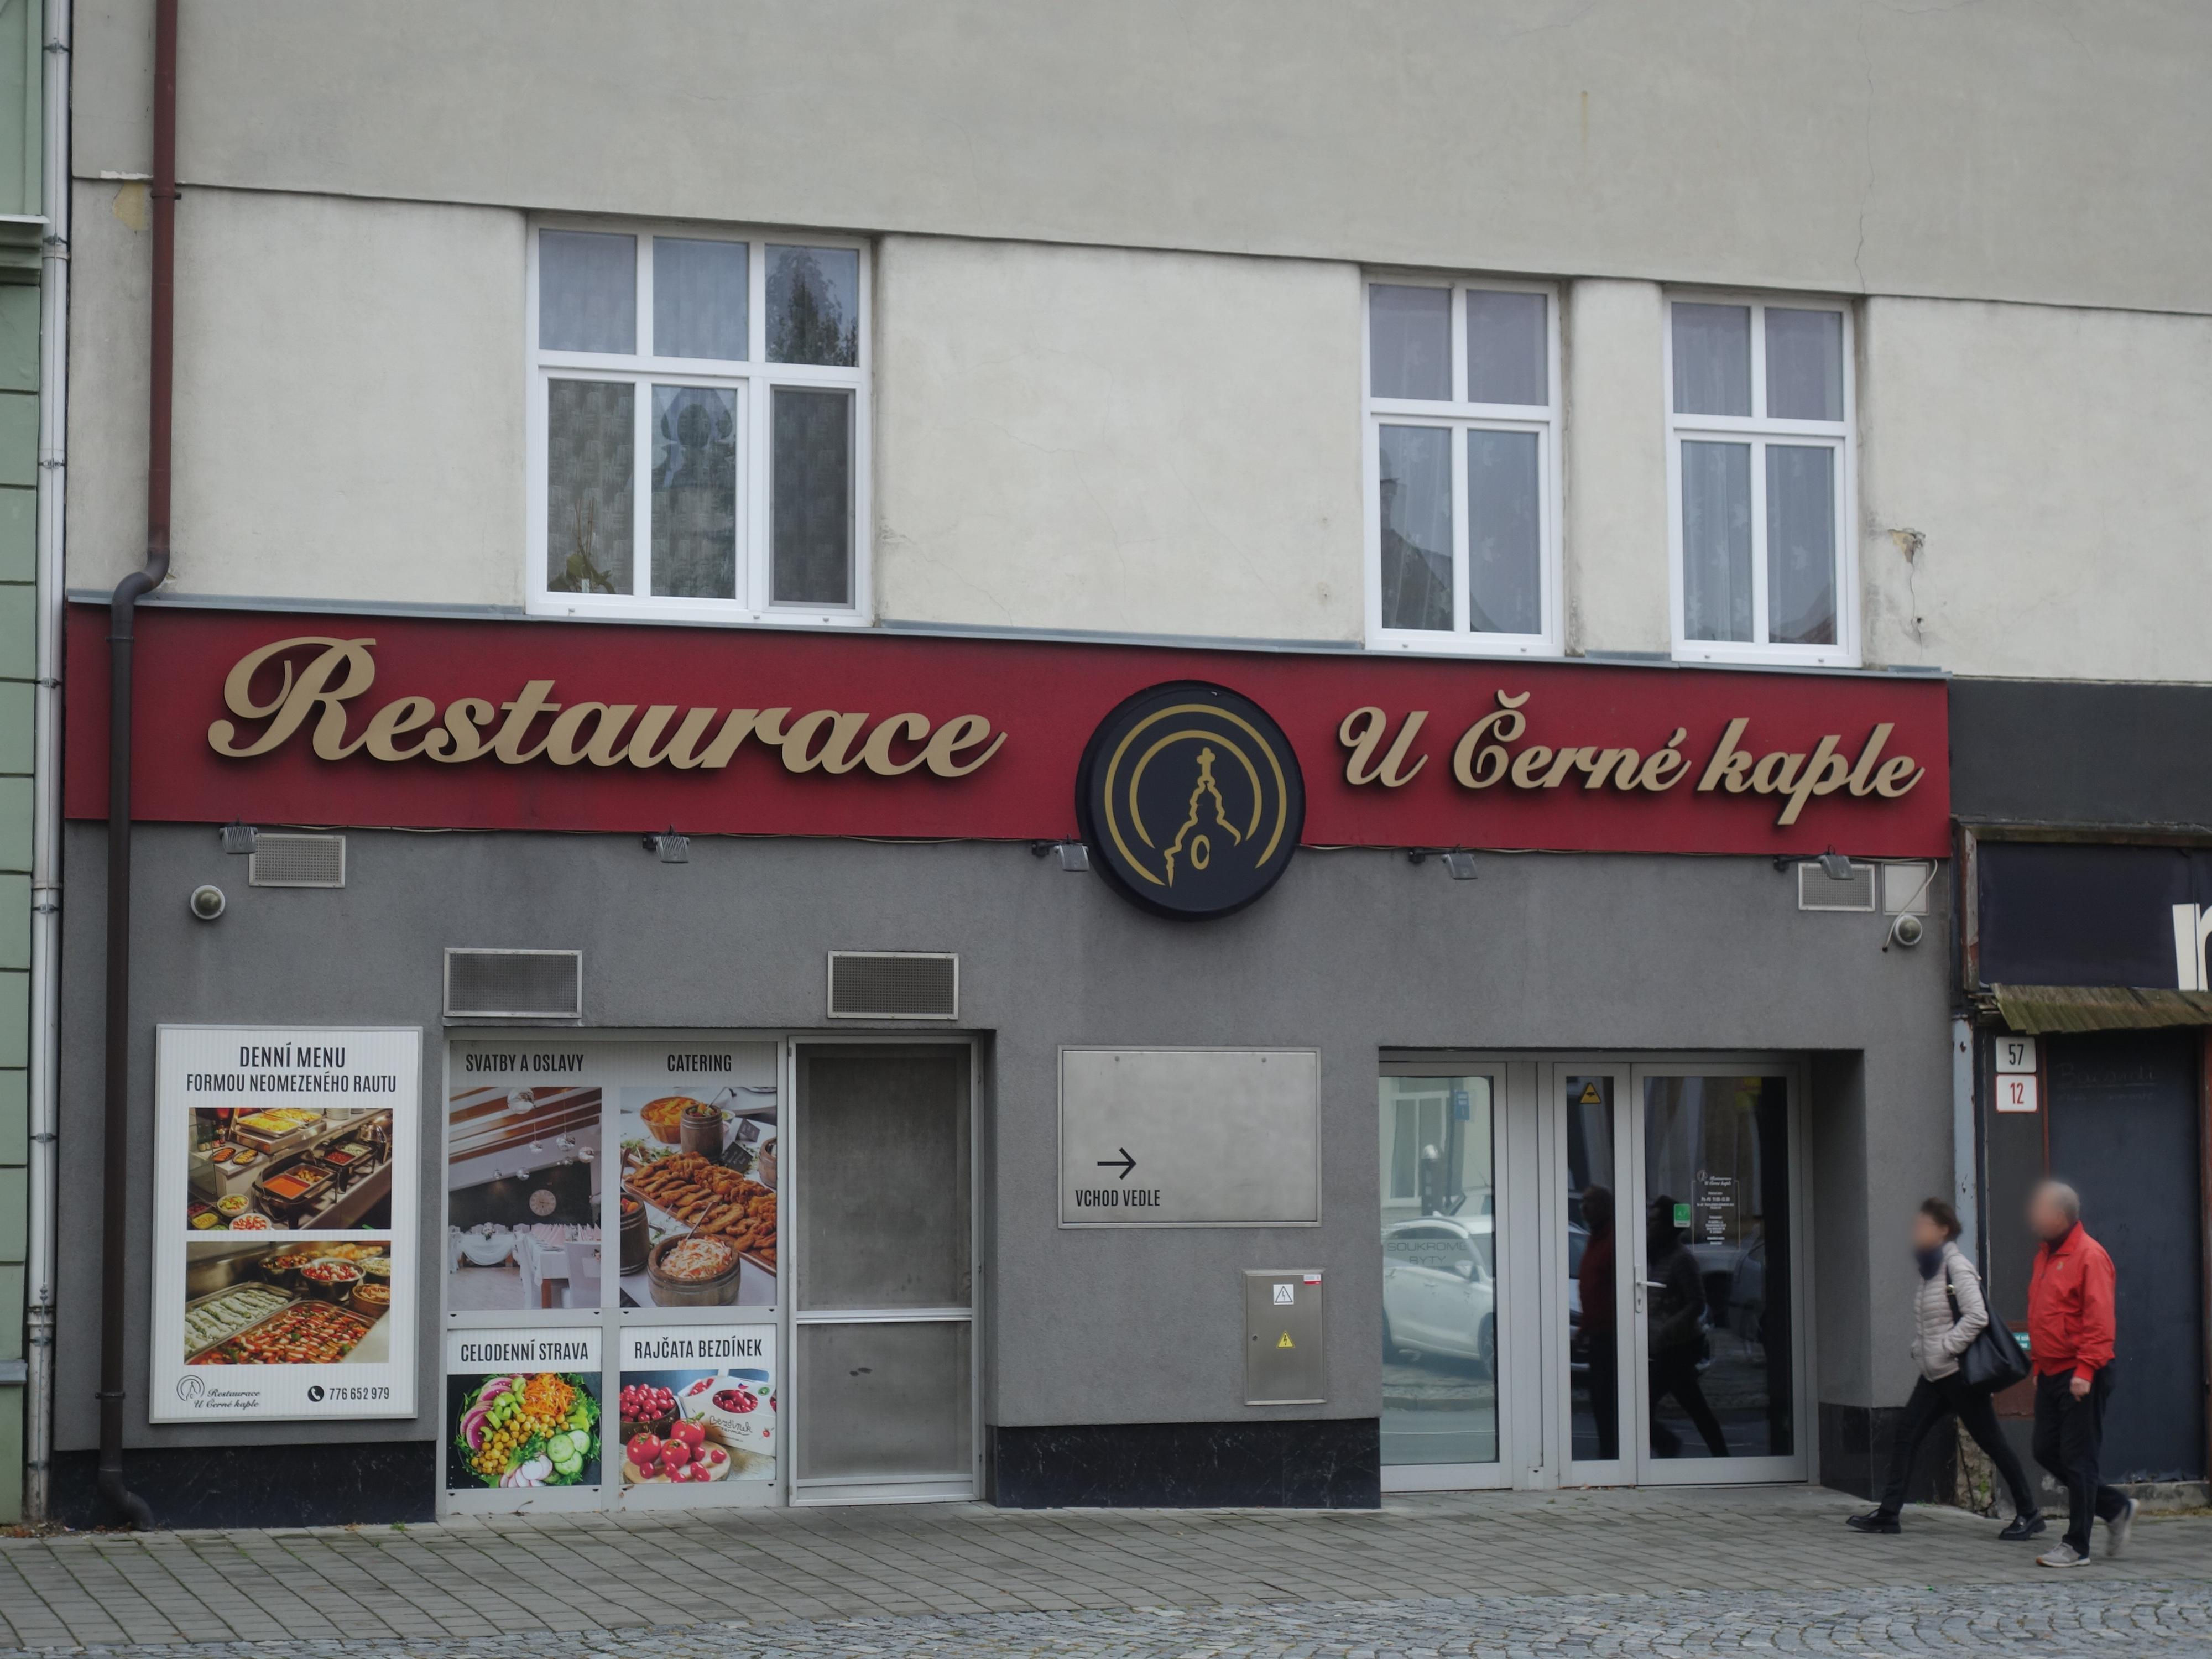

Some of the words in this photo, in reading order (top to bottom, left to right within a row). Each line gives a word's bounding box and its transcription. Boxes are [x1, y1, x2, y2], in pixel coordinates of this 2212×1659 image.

[208, 637, 1008, 777] Restaurace
[1340, 706, 1428, 787] U
[1454, 690, 1691, 791] Černé
[1698, 717, 1924, 825] kaple
[239, 1041, 292, 1067] DENNÍ
[296, 1047, 346, 1068] MENU
[466, 1054, 516, 1072] SVATBY
[520, 1054, 529, 1071] A
[533, 1054, 584, 1071] OSLAVY
[667, 1054, 732, 1072] CATERING
[2008, 1044, 2024, 1066] 57
[186, 1073, 245, 1092] FORMOU
[249, 1071, 349, 1093] NEOMEZENÉHO
[353, 1075, 397, 1093] RAUTU
[2010, 1082, 2024, 1104] 12
[1076, 1190, 1118, 1207] VCHOD
[1123, 1190, 1161, 1207] VEDLE
[1409, 1256, 1446, 1265] BYTY
[461, 1339, 536, 1361] CELODENNÍ
[539, 1342, 589, 1360] STRAVA
[634, 1337, 694, 1359] RAJČATA
[698, 1336, 763, 1358] BEZDÍNEK
[207, 1389, 260, 1397] Restaurace
[330, 1388, 347, 1400] 776
[351, 1388, 368, 1400] 652
[372, 1387, 389, 1399] 979
[234, 1399, 259, 1410] kaple
